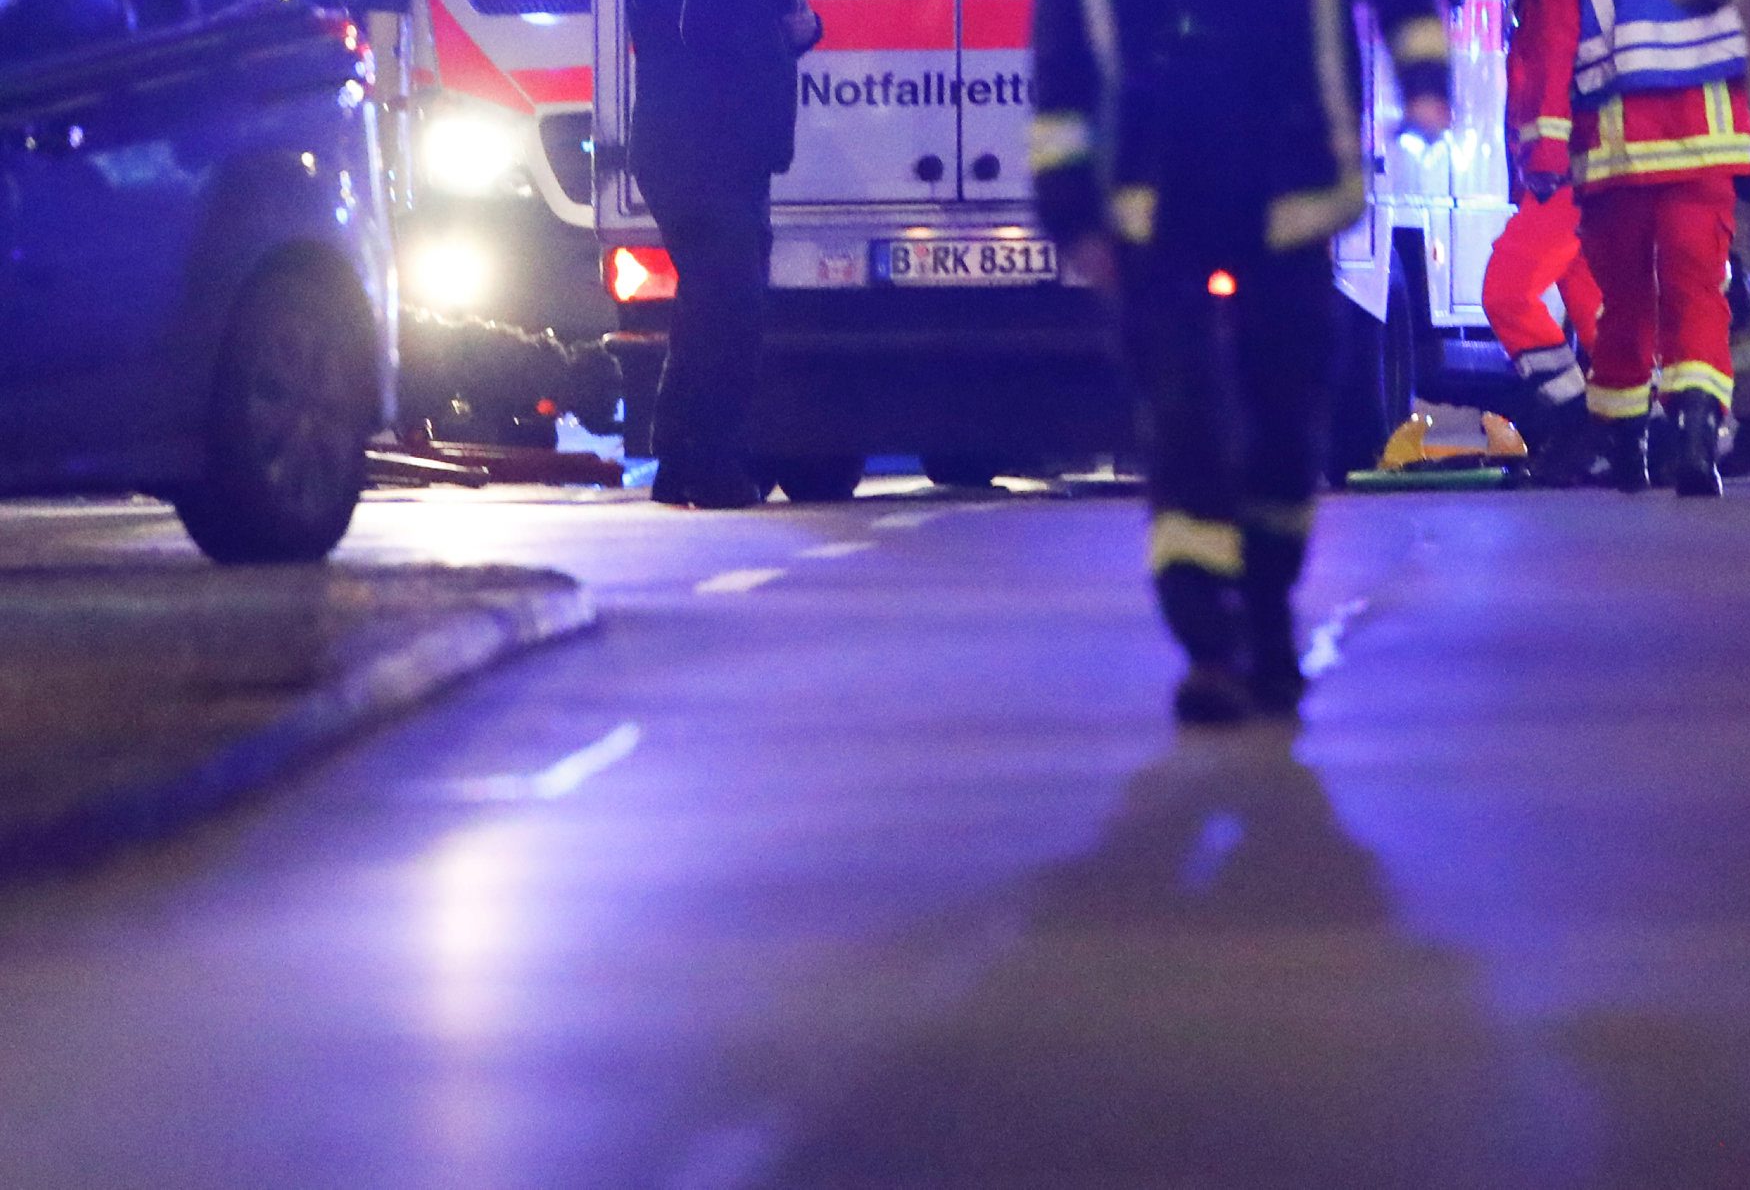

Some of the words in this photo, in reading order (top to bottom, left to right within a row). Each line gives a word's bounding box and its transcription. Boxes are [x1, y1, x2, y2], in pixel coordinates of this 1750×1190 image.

[891, 245, 911, 275] B
[932, 245, 971, 275] RK
[979, 245, 1055, 275] 8311
